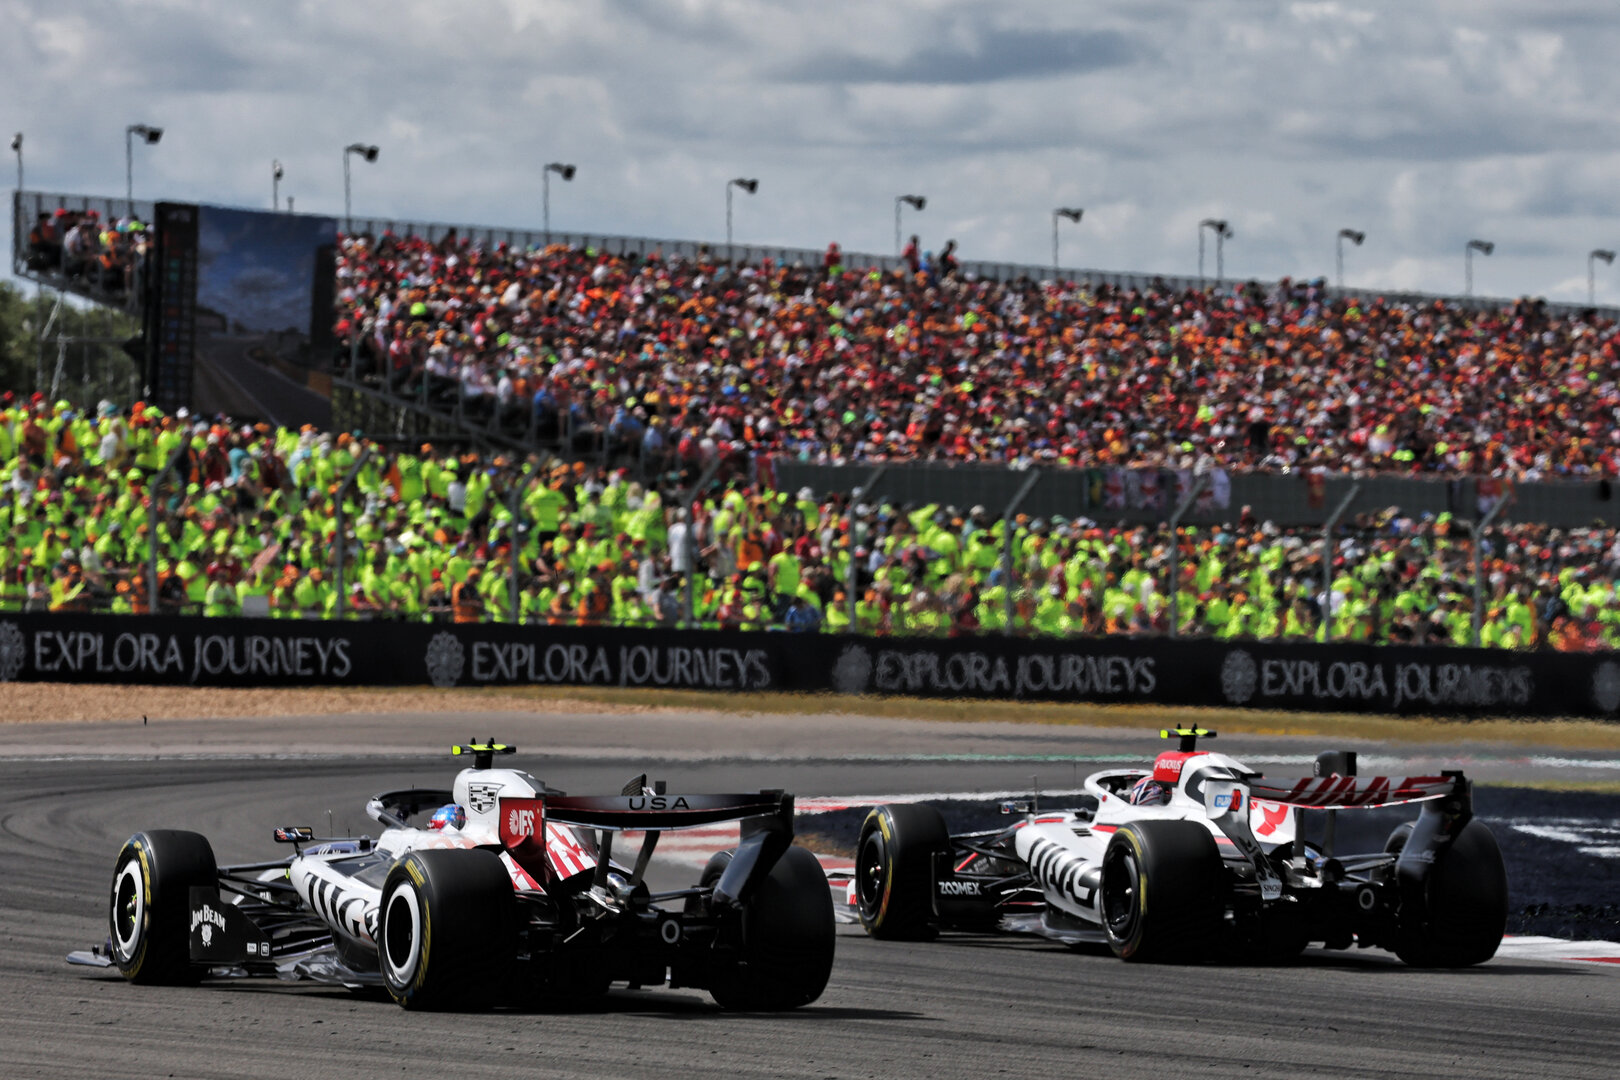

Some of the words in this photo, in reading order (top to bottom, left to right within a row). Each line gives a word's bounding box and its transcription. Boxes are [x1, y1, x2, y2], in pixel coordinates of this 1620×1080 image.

[34, 630, 184, 674] EXPLORA
[190, 635, 352, 684] JOURNEYS
[471, 641, 612, 683] EXPLORA
[618, 645, 771, 688] JOURNEYS
[876, 650, 1011, 691] EXPLORA
[1016, 654, 1157, 697] JOURNEYS
[1262, 659, 1388, 698] EXPLORA
[628, 796, 690, 811] USA
[1268, 776, 1453, 807] HAAS
[518, 808, 535, 837] IFS
[938, 881, 982, 896] ZOOMEX
[190, 909, 203, 933] JIM
[203, 904, 226, 933] BEAM
